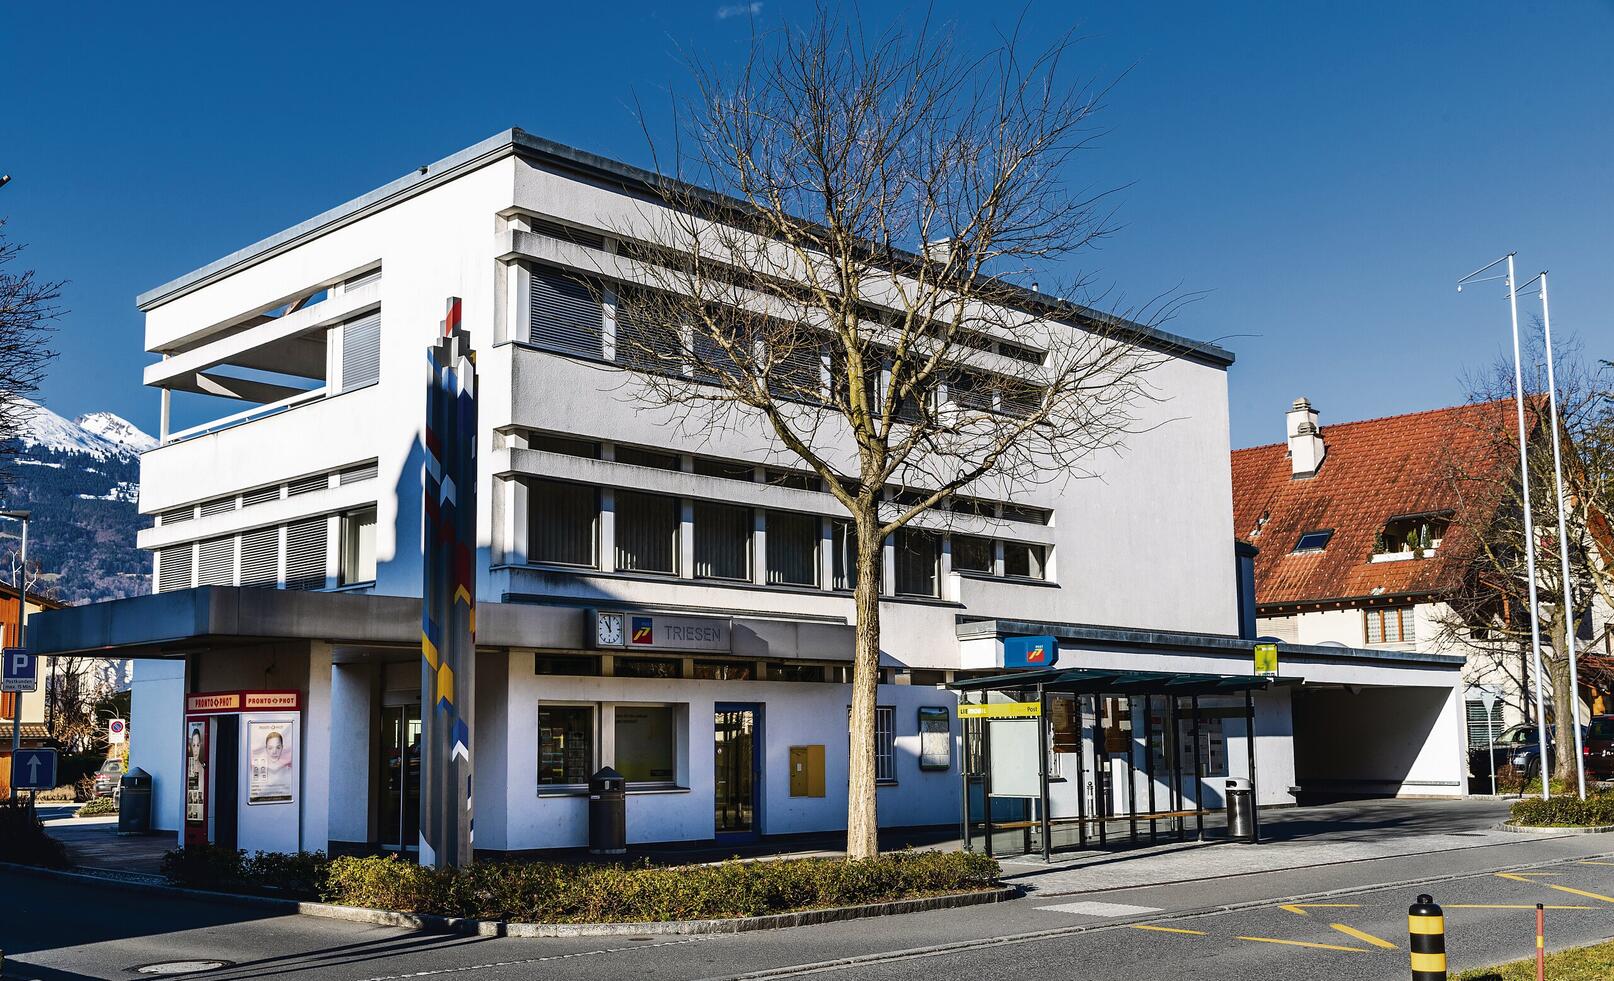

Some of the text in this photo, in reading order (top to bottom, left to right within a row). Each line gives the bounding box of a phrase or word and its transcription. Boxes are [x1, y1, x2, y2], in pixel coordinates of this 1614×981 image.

[664, 625, 721, 642] TRIESEN
[12, 654, 28, 675] P
[195, 697, 233, 708] PRONTO PHOT
[1026, 705, 1038, 713] Post
